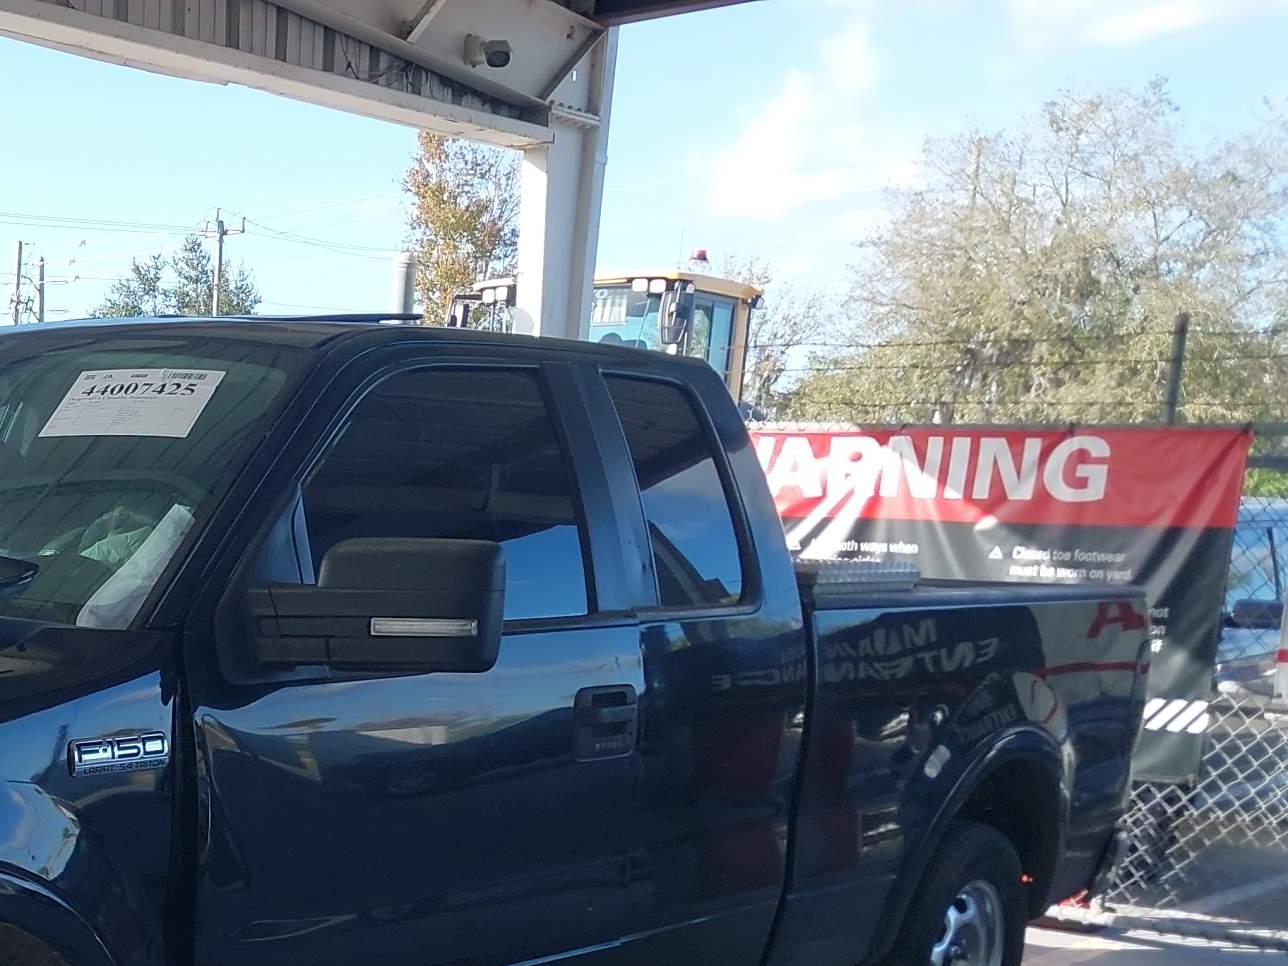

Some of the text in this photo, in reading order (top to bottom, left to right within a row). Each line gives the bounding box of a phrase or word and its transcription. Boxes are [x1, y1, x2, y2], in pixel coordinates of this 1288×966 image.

[81, 382, 198, 397] 44007425
[1052, 550, 1072, 561] toe
[1073, 549, 1127, 562] footwear
[1088, 568, 1104, 579] on
